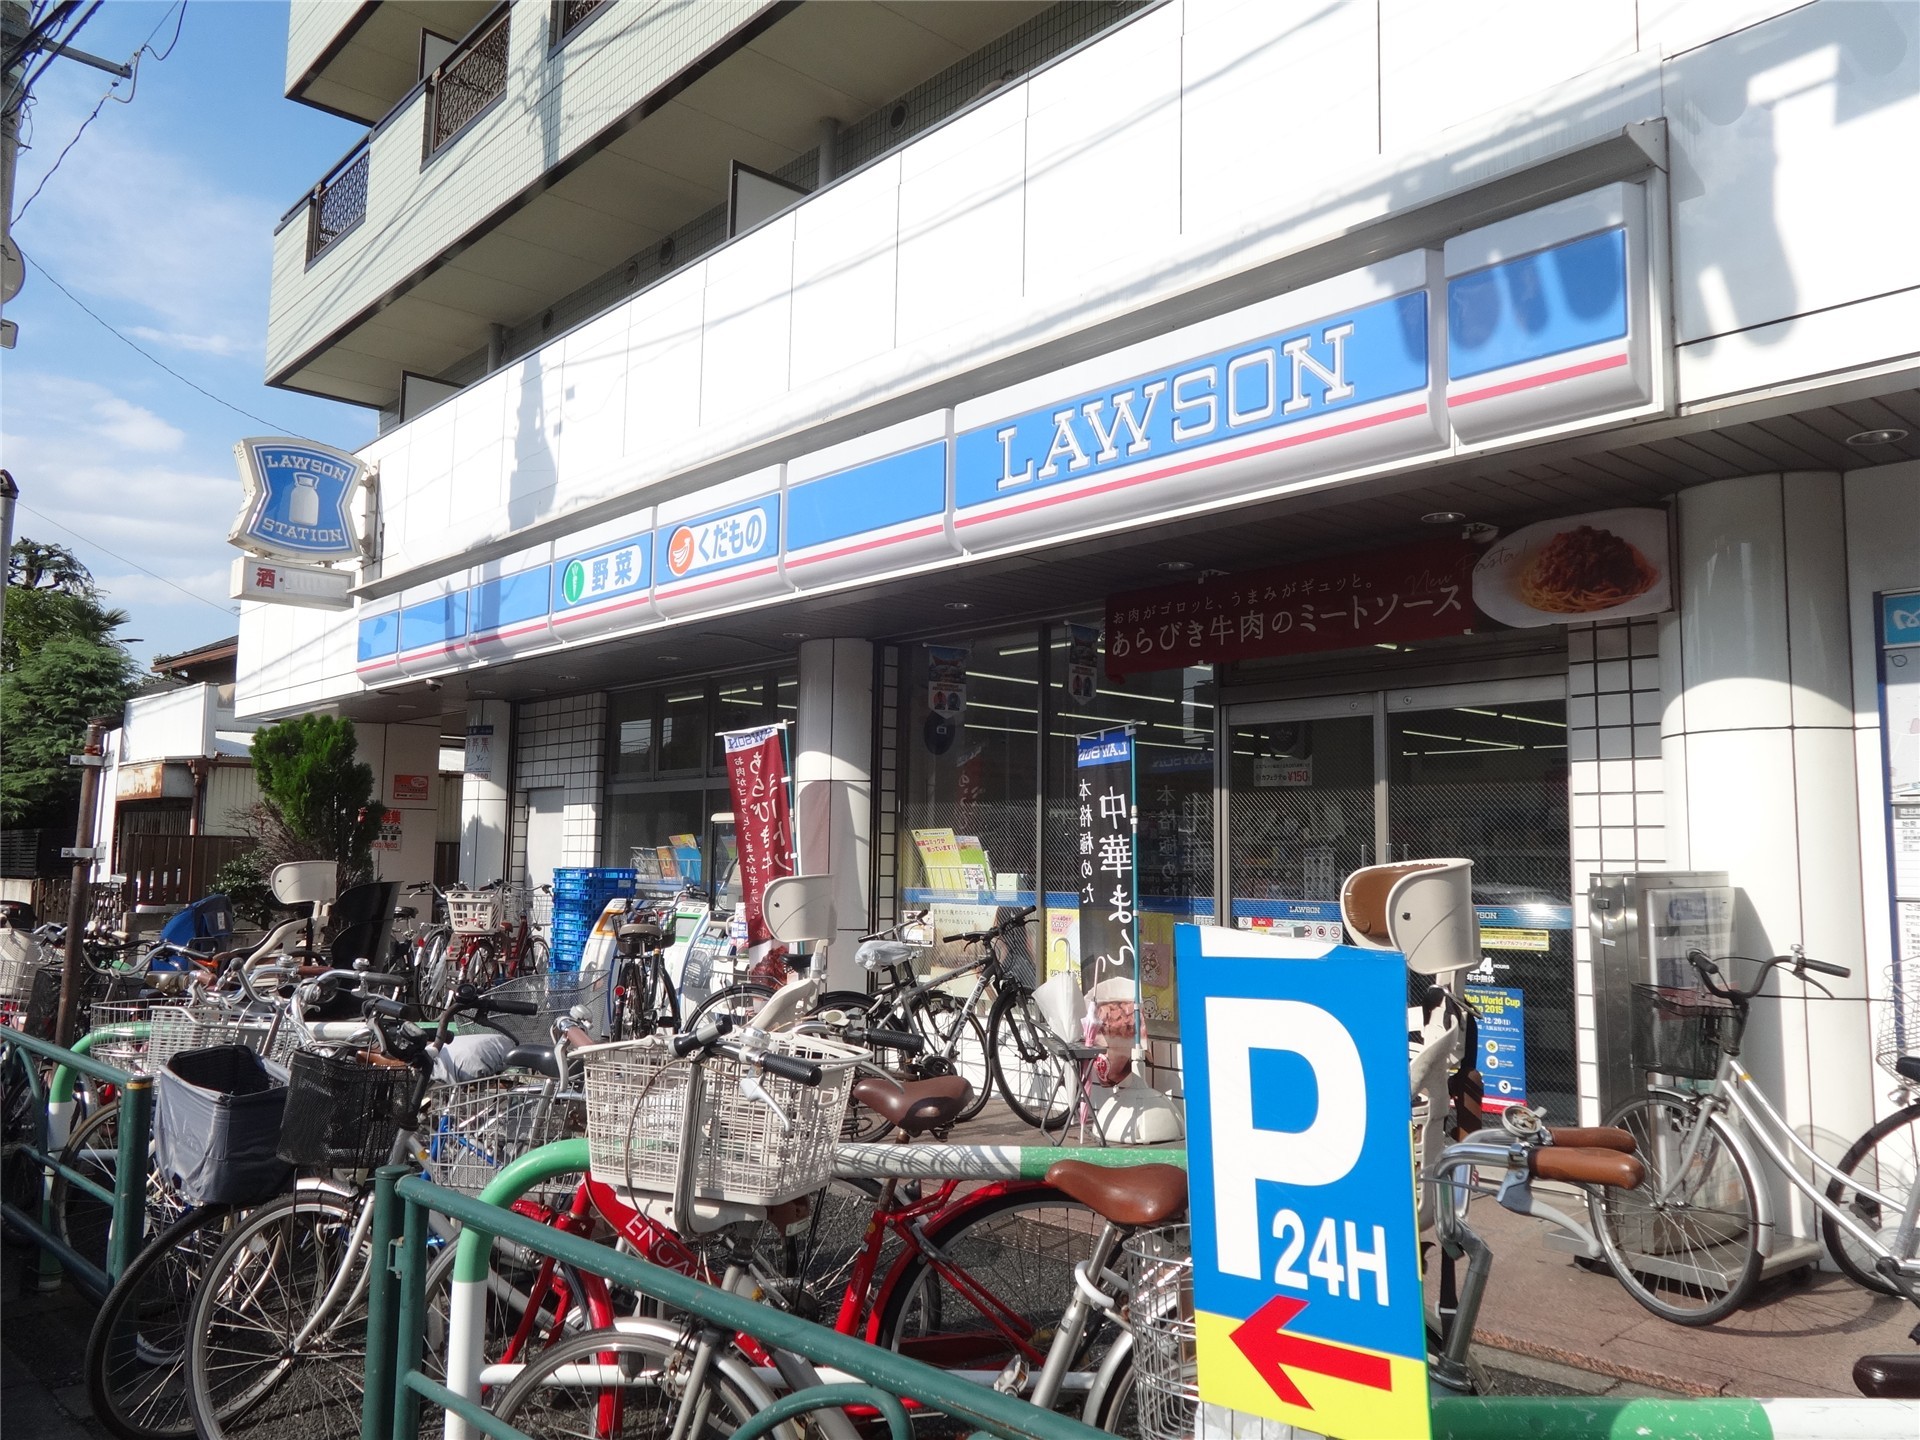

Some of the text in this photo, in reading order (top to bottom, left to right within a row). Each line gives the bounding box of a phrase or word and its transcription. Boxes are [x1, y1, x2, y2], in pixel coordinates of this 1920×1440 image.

[996, 321, 1354, 491] LAWSON
[265, 455, 347, 481] LAWSON
[262, 518, 342, 542] STATION
[698, 514, 761, 562] くだもの
[591, 549, 633, 592] 野菜
[1112, 573, 1373, 626] お肉がゴロッと、うまみがギュッと。
[1112, 585, 1462, 657] あらびき牛肉のミートソース
[1481, 995, 1503, 1005] World
[1505, 997, 1521, 1008] Cup
[1205, 997, 1367, 1280] P
[1272, 1208, 1389, 1307] 24H
